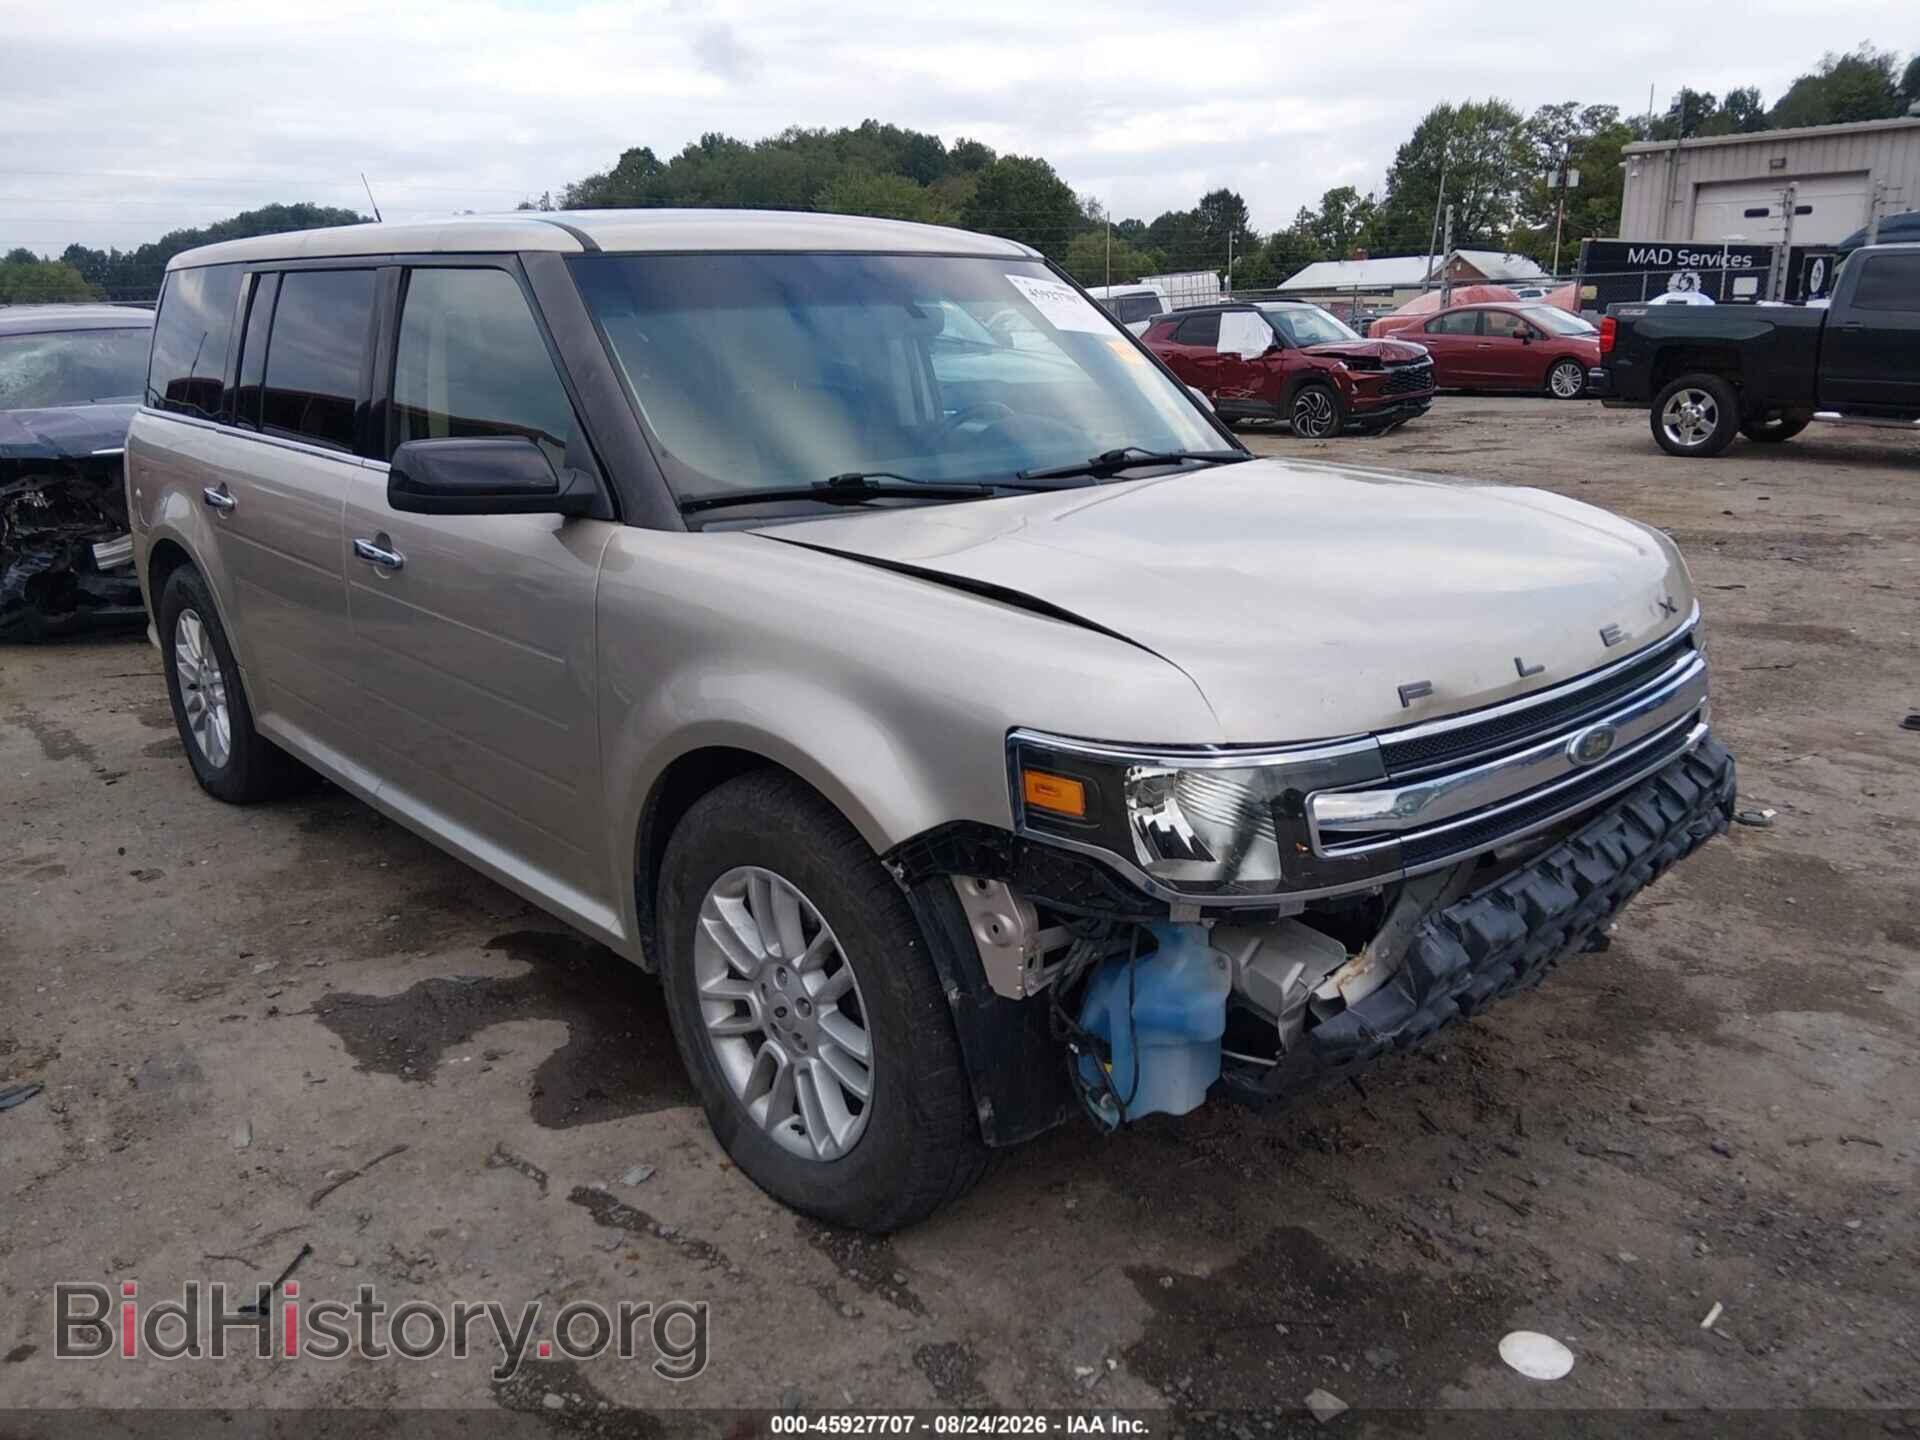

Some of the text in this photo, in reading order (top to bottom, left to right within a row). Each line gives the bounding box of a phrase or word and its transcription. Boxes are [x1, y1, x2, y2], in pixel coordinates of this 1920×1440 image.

[1627, 248, 1752, 268] MAD Services
[1398, 597, 1678, 708] FLEX
